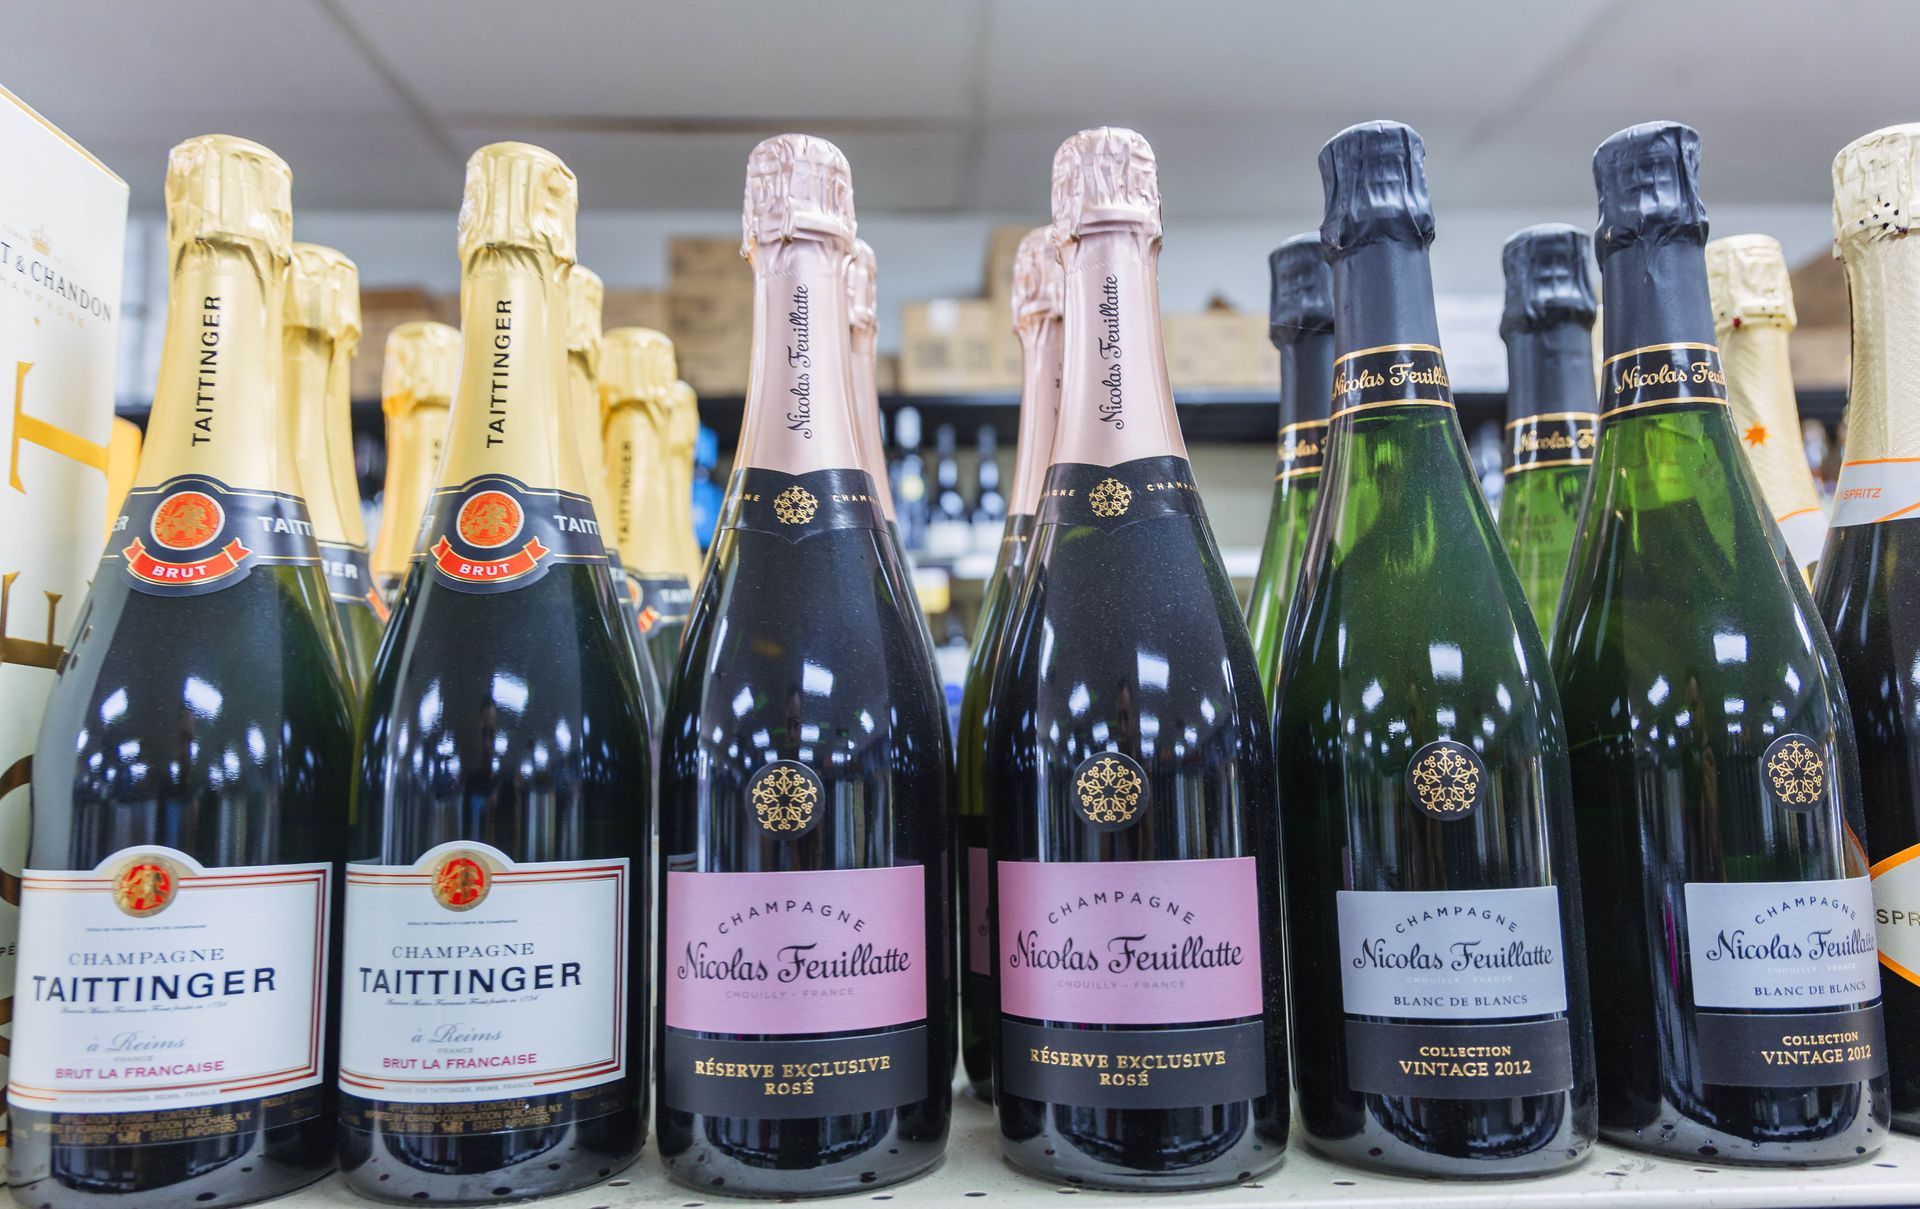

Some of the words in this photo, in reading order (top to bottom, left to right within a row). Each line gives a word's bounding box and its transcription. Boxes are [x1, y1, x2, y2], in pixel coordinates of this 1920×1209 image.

[31, 261, 112, 323] CHANDON
[788, 284, 812, 369] Feuillatte
[1097, 273, 1122, 359] Feuillatte
[192, 296, 222, 447] TAITTINGER
[487, 299, 512, 448] TAITTINGER
[1614, 363, 1688, 394] Nicolas
[1332, 369, 1385, 400] Nicolas
[787, 372, 813, 439] Nicolas
[1099, 363, 1125, 430] Nicolas
[618, 440, 633, 544] TAITTINGER
[1843, 487, 1884, 501] SPRITZ
[152, 565, 207, 578] BRUT
[459, 563, 510, 576] BRUT
[718, 900, 866, 935] CHAMPAGNE
[1048, 891, 1195, 925] CHAMPAGNE
[1755, 896, 1857, 925] CHAMPAGNE
[1395, 906, 1518, 934] CHAMPAGNE
[391, 942, 535, 960] CHAMPAGNE
[1010, 930, 1099, 971] Nicolas
[1108, 933, 1245, 973] Feuillatte
[1353, 938, 1443, 970] Nicolas
[1450, 940, 1554, 972] Feuillatte
[1706, 929, 1802, 961] Nicolas
[68, 948, 225, 966] CHAMPAGNE
[677, 941, 768, 981] Nicolas
[777, 943, 911, 983] Feuillatte
[33, 967, 276, 1003] TAITTINGER
[359, 962, 582, 995] TAITTINGER
[1057, 979, 1117, 990] CHOUILLY
[1134, 979, 1186, 989] FRANCE
[1754, 985, 1804, 997] BLANC
[1809, 985, 1825, 996] DE
[1829, 981, 1866, 994] BLANCS
[726, 989, 786, 1000] CHOUILLY
[803, 987, 855, 998] FRANCE
[1393, 996, 1444, 1007] BLANC
[1450, 996, 1469, 1007] DE
[1475, 994, 1528, 1007] BLANCS
[86, 1035, 100, 1053] à
[103, 1030, 186, 1053] Reims
[411, 1027, 423, 1043] à
[430, 1023, 503, 1044] Reims
[1782, 1031, 1859, 1046] COLLECTION
[382, 1056, 418, 1070] BRUT
[422, 1057, 441, 1070] LA
[446, 1053, 538, 1069] FRANCAISE
[1030, 1046, 1109, 1068] RÉSERVE
[1117, 1050, 1226, 1069] EXCLUSIVE
[1419, 1046, 1512, 1057] COLLECTION
[1761, 1048, 1844, 1065] VINTAGE
[1847, 1045, 1872, 1061] 2012
[55, 1067, 93, 1081] BRUT
[99, 1067, 119, 1080] LA
[125, 1060, 226, 1079] FRANCAISE
[694, 1057, 775, 1078] RÉSERVE
[782, 1055, 890, 1078] EXCLUSIVE
[1099, 1070, 1149, 1086] ROSÉ
[1399, 1061, 1489, 1076] VINTAGE
[1494, 1060, 1532, 1076] 2012
[764, 1080, 814, 1095] ROSÉ
